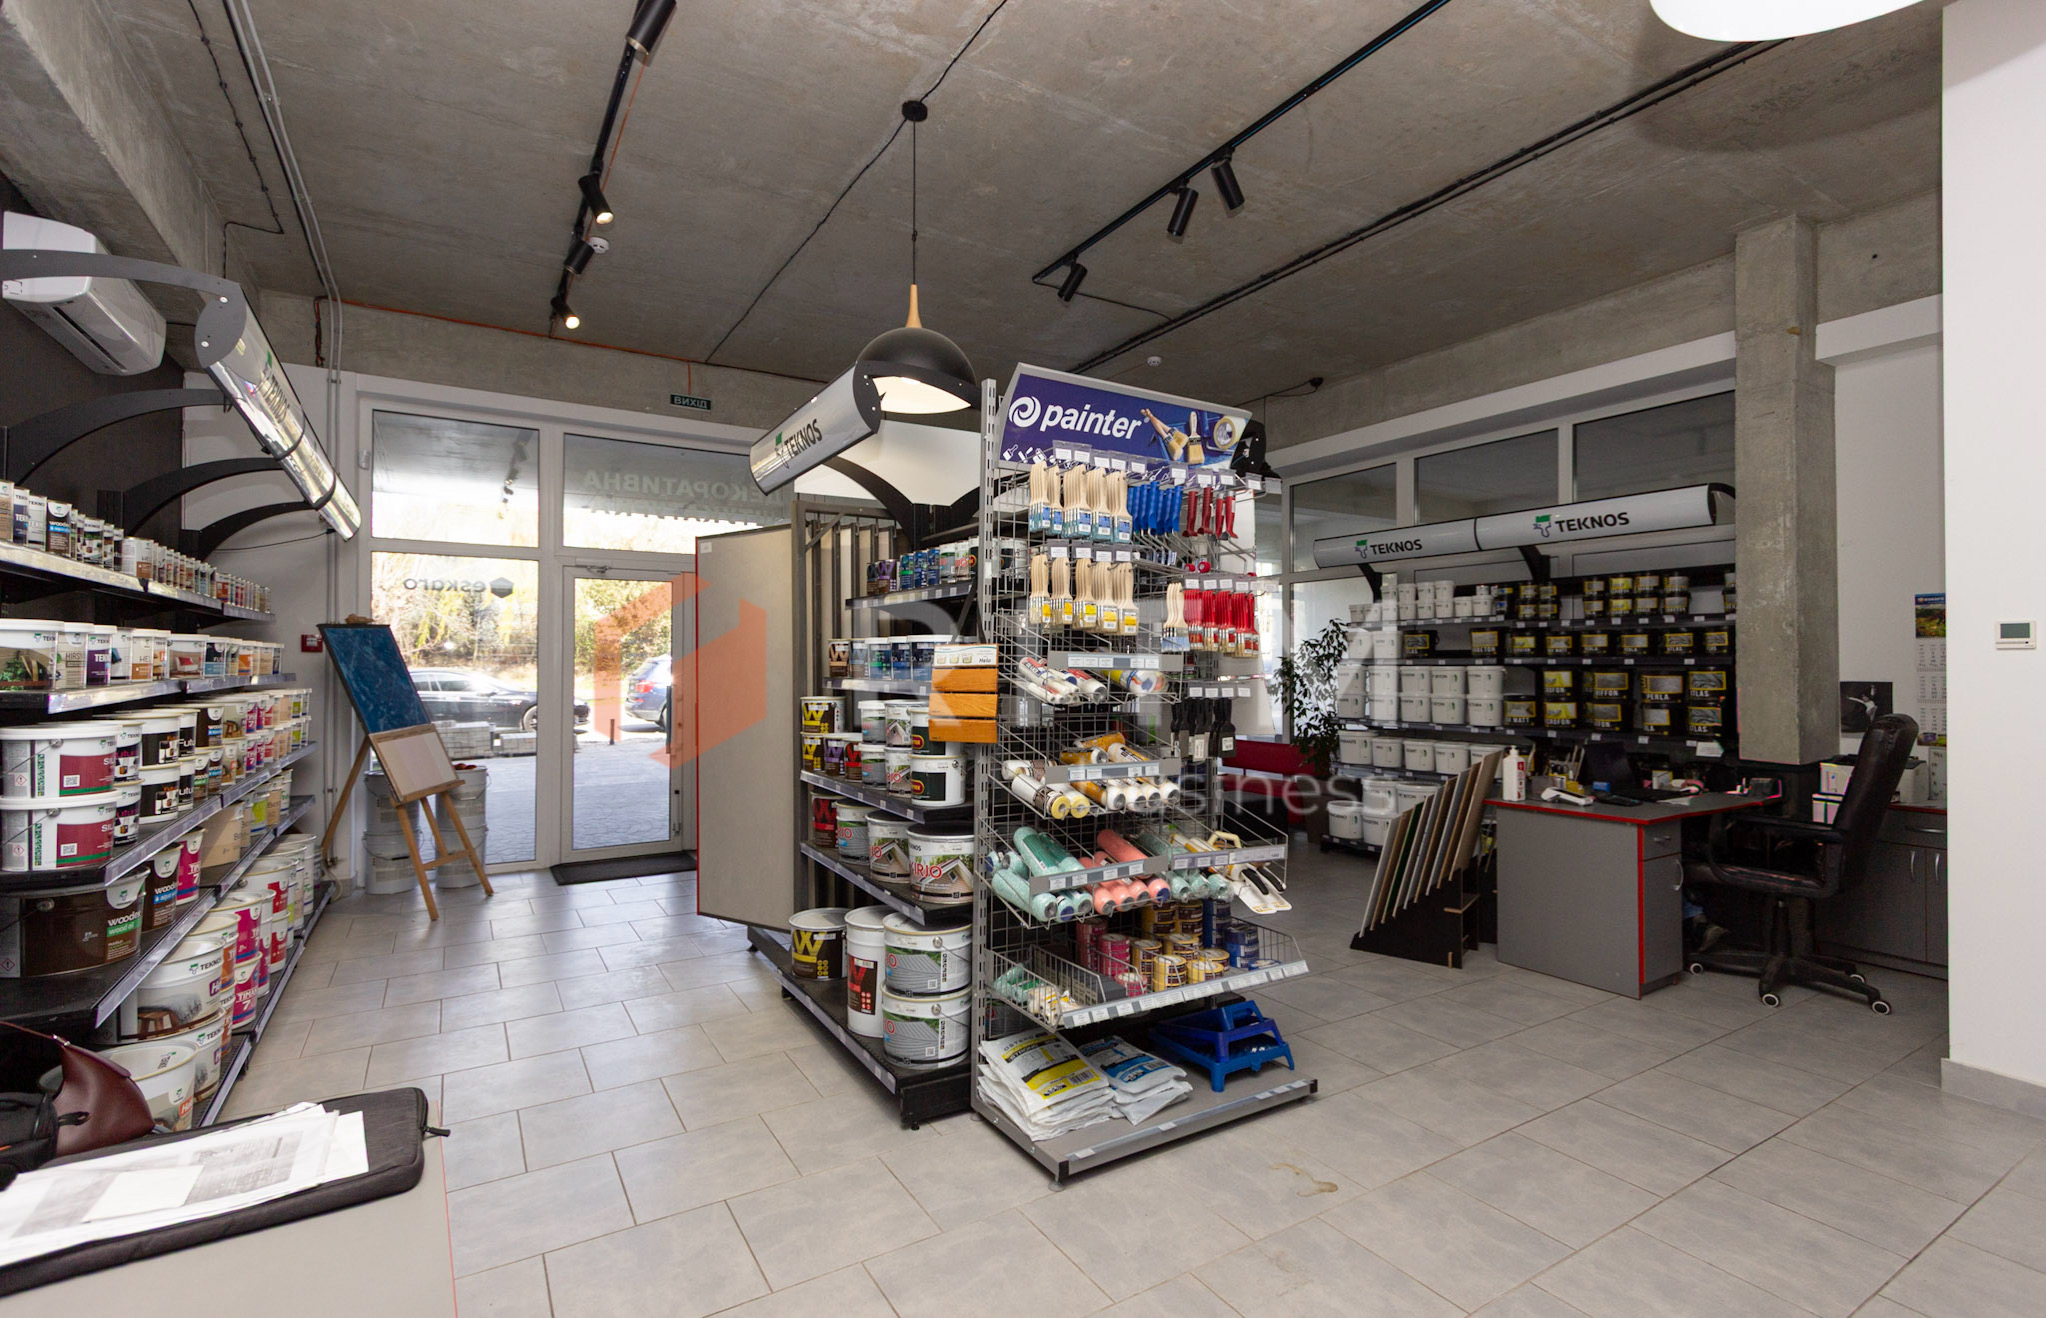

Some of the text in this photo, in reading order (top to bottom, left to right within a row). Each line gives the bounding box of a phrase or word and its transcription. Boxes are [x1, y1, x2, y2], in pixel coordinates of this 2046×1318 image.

[674, 396, 709, 410] ВИХІД
[1040, 404, 1143, 439] painter
[784, 418, 823, 459] TEKNOS
[1555, 512, 1630, 533] TEKNOS
[1370, 539, 1423, 555] TEKNOS
[242, 999, 251, 1011] 7
